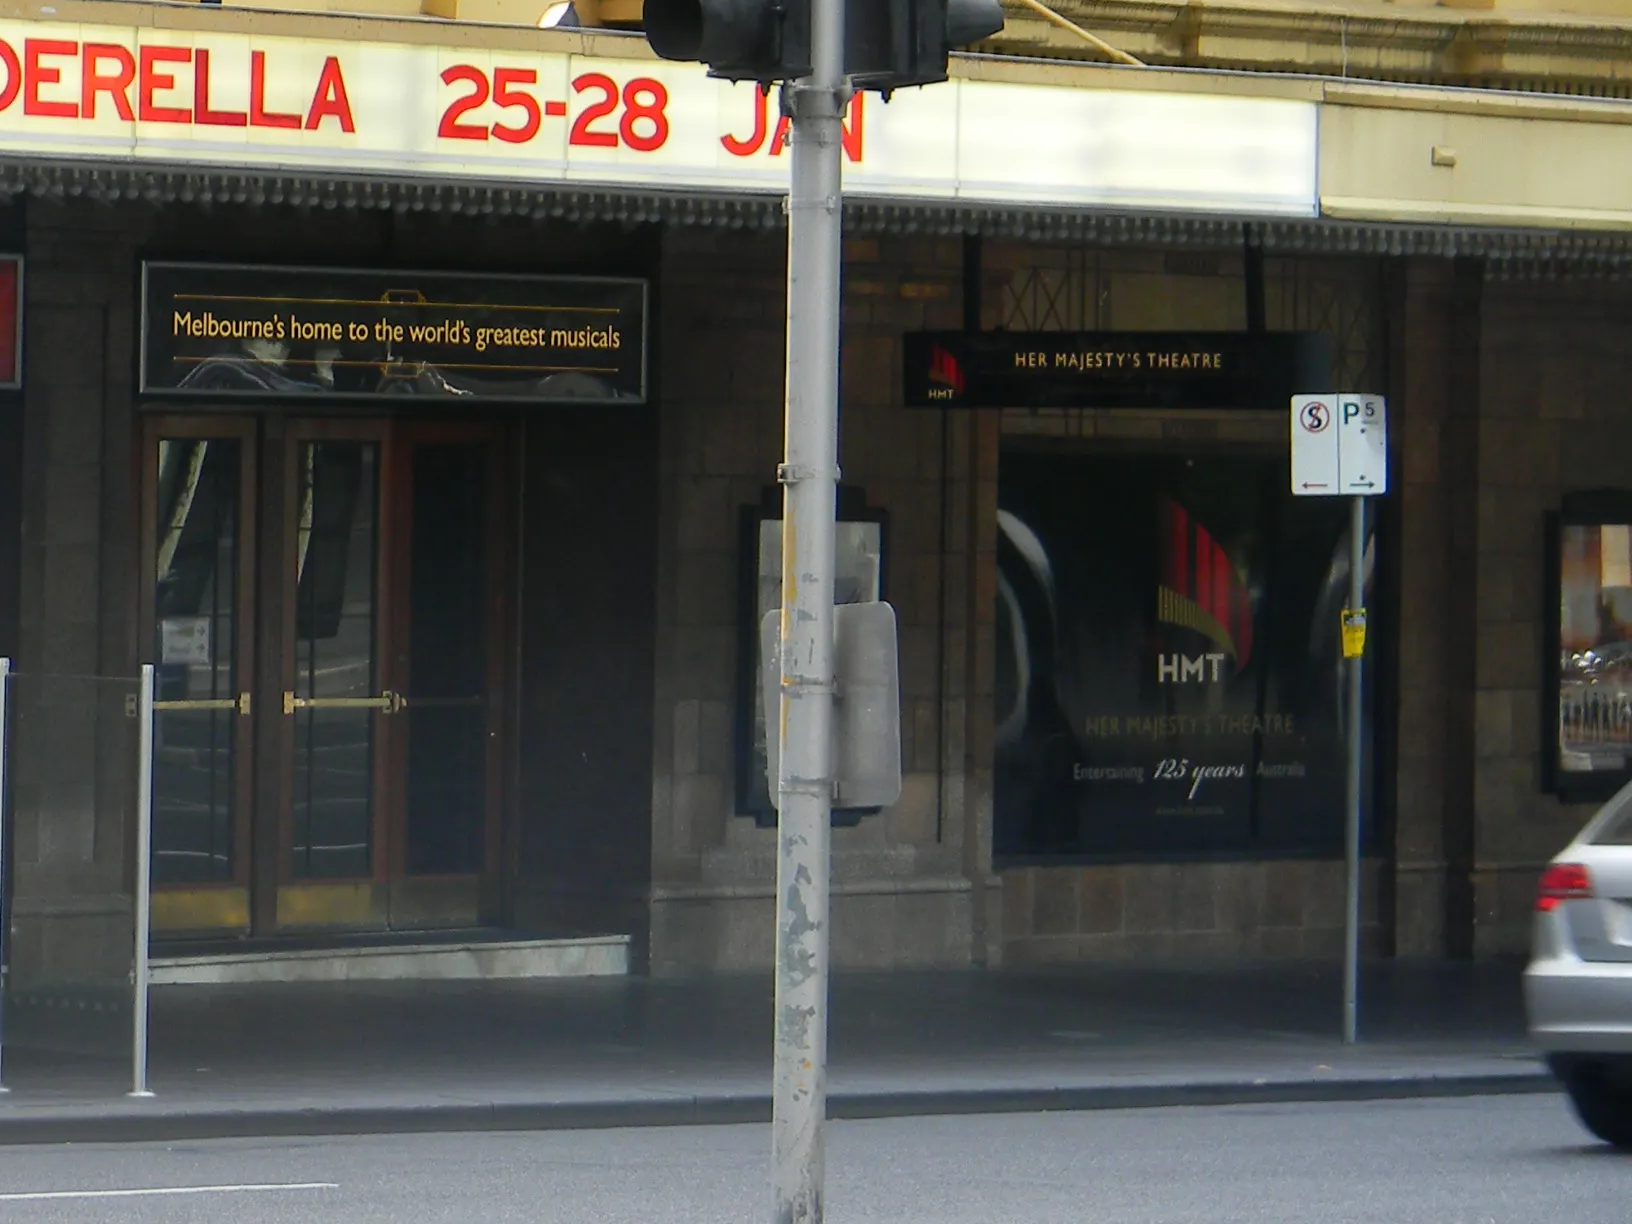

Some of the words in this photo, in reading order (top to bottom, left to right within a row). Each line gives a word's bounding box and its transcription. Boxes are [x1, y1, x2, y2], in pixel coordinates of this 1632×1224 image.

[437, 63, 669, 152] 25-28
[174, 311, 285, 338] Melbourne's
[291, 315, 342, 339] home
[349, 321, 368, 341] to
[375, 318, 403, 342] the
[409, 320, 470, 344] world's
[475, 327, 545, 351] greatest
[551, 325, 620, 349] musicals
[1015, 352, 1047, 367] HER
[1055, 352, 1141, 371] MAJESTY'S
[1147, 353, 1221, 368] THEATRE
[929, 389, 954, 400] HMT
[1344, 402, 1359, 425] P
[1158, 653, 1224, 682] HMT
[1085, 715, 1119, 736] HER
[1219, 714, 1294, 735] THEATRE
[1153, 759, 1187, 779] 125
[1187, 761, 1245, 799] years
